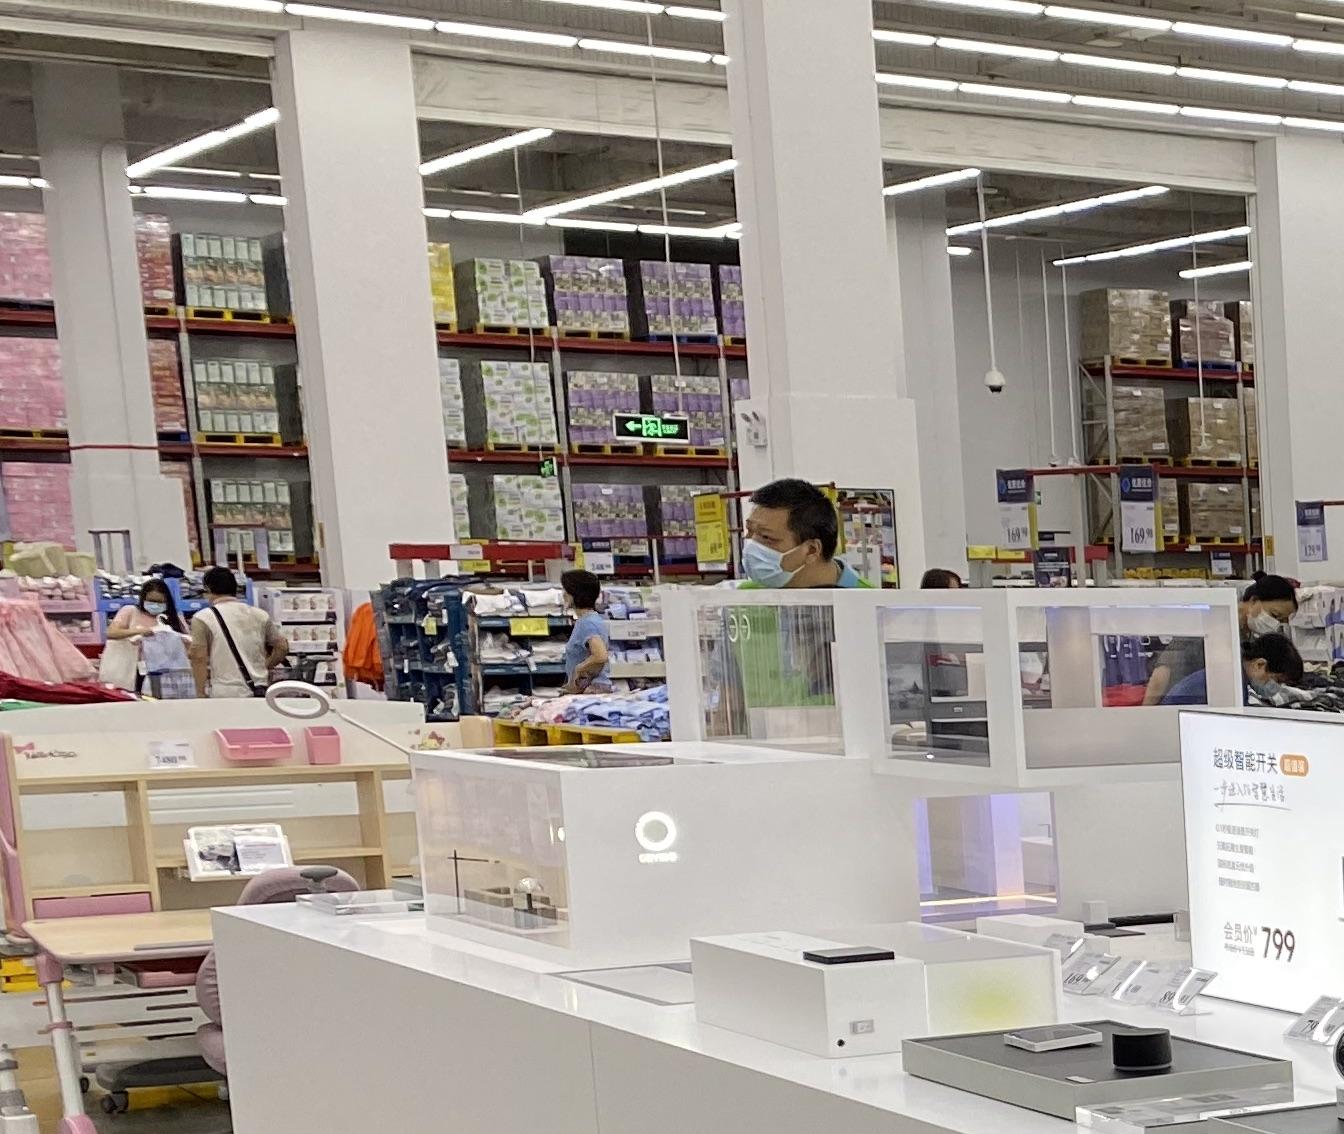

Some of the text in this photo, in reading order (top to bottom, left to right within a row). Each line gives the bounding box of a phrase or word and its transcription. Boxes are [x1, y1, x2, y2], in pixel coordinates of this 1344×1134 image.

[1213, 746, 1279, 774] 超级智能开关
[1261, 926, 1296, 963] 799
